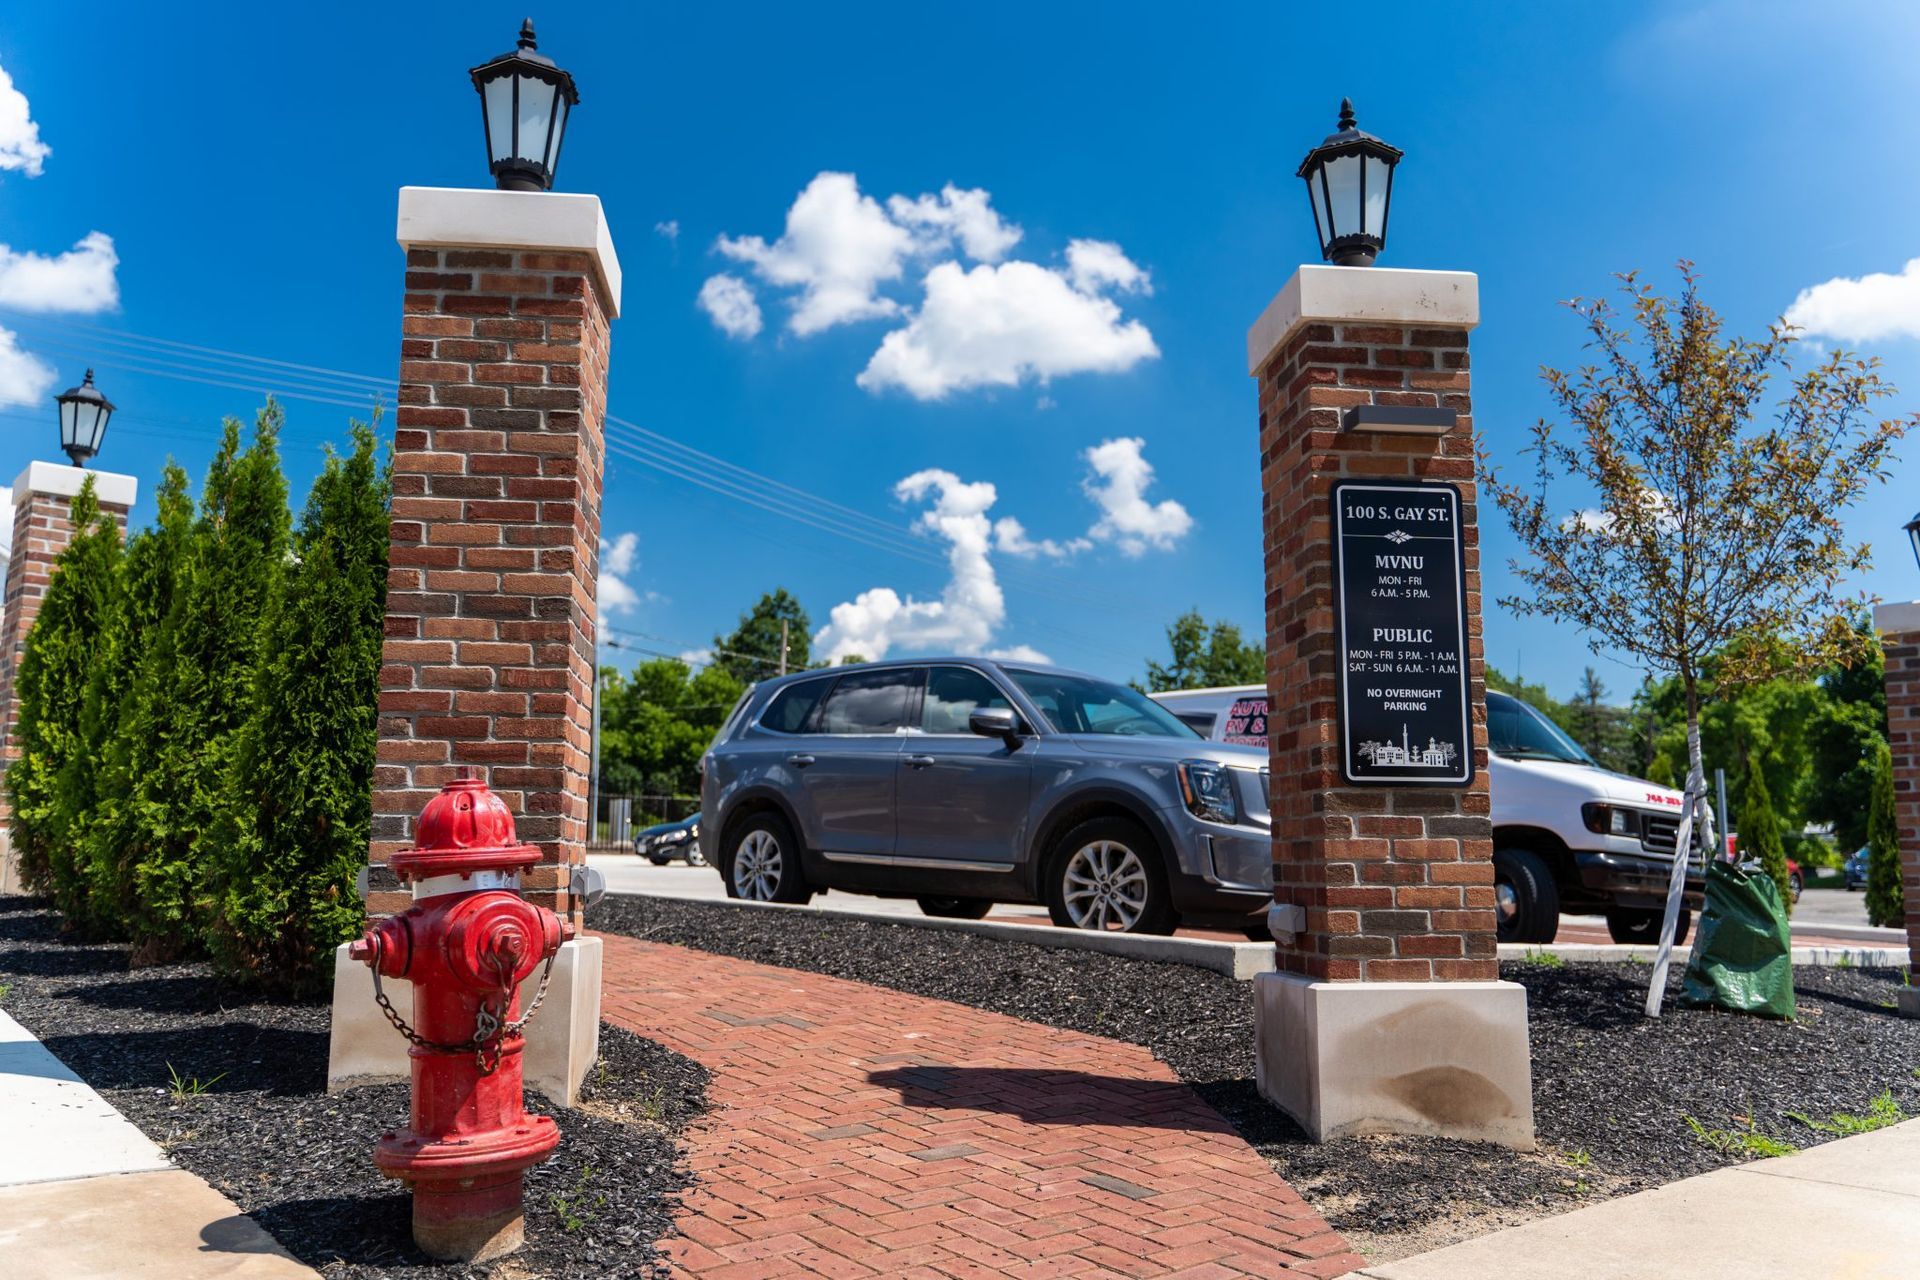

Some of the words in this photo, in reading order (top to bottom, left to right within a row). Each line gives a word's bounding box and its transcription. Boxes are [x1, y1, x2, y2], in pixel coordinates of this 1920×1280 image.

[1346, 506, 1375, 519] 100
[1378, 506, 1391, 519] S.
[1394, 507, 1425, 521] GAY
[1428, 508, 1449, 521] ST.
[1375, 555, 1424, 570] MVNU
[1378, 575, 1401, 585] MON
[1408, 576, 1422, 585] FRI
[1371, 588, 1378, 597] 6
[1379, 588, 1399, 598] A.M.
[1405, 589, 1411, 598] 5
[1413, 589, 1431, 599] P.M.
[1373, 628, 1433, 643] PUBLIC
[1350, 650, 1373, 659] MON
[1380, 650, 1394, 660] FRI
[1398, 651, 1403, 660] 5
[1405, 651, 1423, 660] P.M.
[1430, 652, 1434, 660] 1
[1437, 652, 1457, 661] A.M.
[1349, 662, 1366, 672] SAT
[1373, 663, 1393, 672] SUN
[1396, 664, 1403, 673] 6
[1404, 664, 1424, 673] A.M.
[1431, 665, 1436, 673] 1
[1438, 665, 1458, 674] A.M.
[1367, 688, 1382, 698] NO
[1385, 688, 1442, 698] OVERNIGHT
[1384, 701, 1427, 711] PARKING
[1225, 718, 1250, 734] RV
[1251, 717, 1265, 734] &
